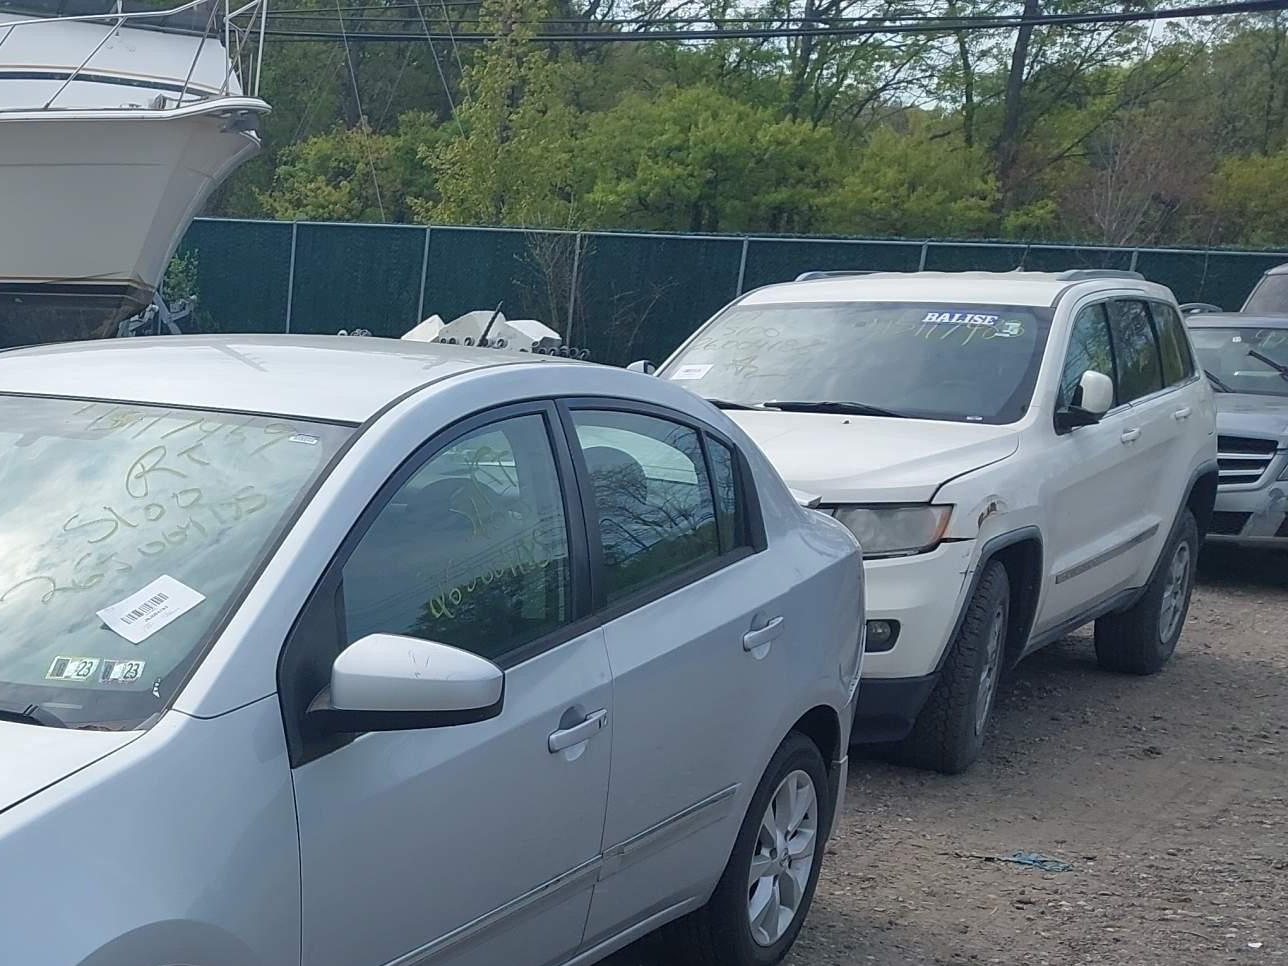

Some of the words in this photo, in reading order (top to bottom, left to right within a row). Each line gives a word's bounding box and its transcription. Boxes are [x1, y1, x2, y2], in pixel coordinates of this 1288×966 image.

[922, 312, 999, 325] BALISE
[76, 661, 93, 677] 23
[123, 662, 140, 679] 23
